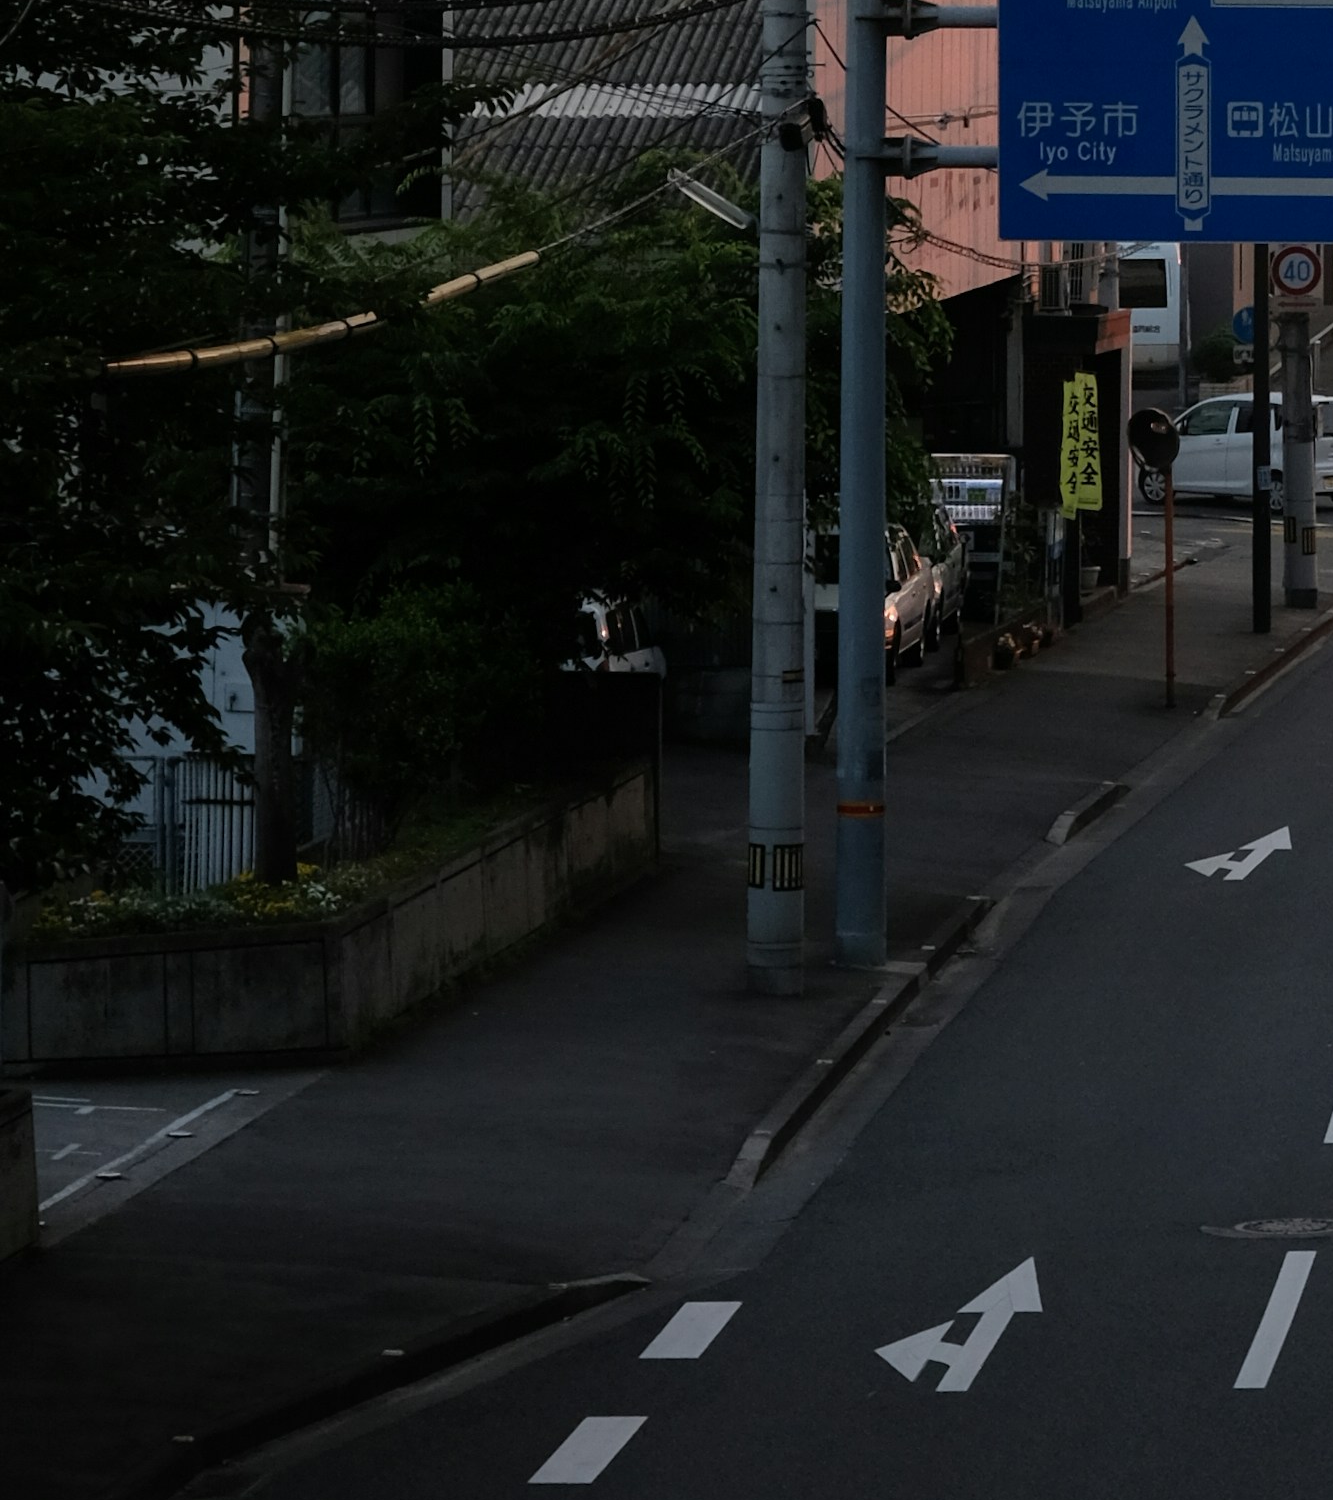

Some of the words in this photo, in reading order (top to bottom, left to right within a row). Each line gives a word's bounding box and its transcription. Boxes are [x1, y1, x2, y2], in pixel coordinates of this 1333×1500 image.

[1017, 101, 1138, 138] 伊予市
[1182, 71, 1205, 204] サクラメント通り
[1040, 141, 1068, 165] Iyo
[1078, 141, 1116, 165] City
[1283, 260, 1310, 282] 40
[1081, 383, 1098, 486] 交通安全
